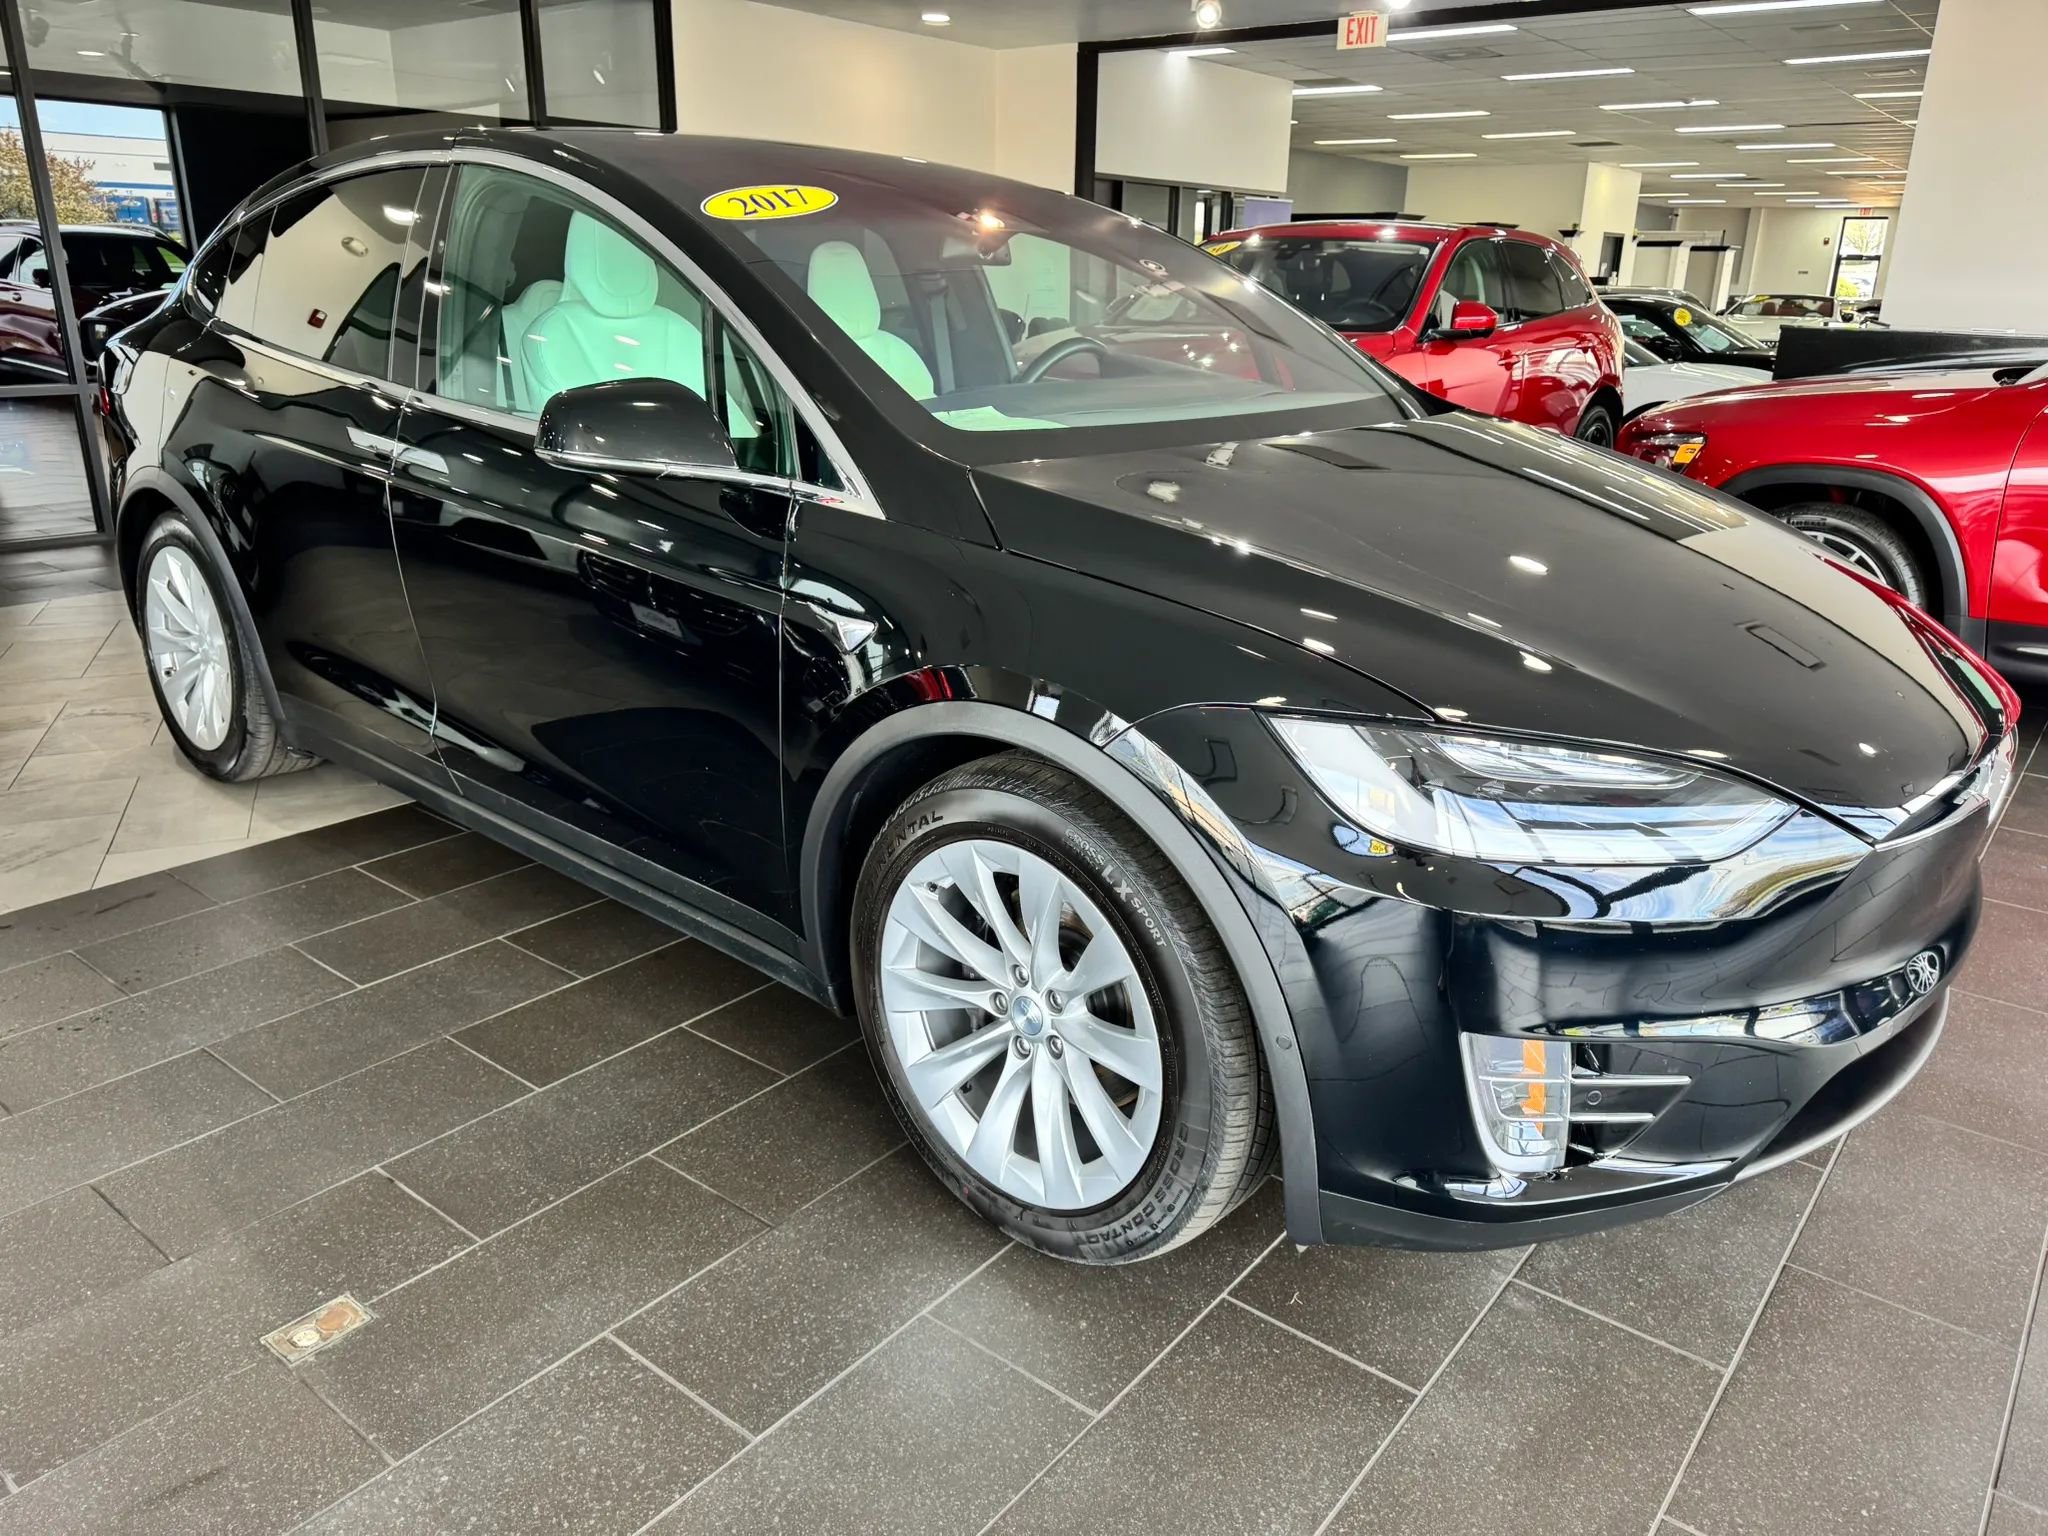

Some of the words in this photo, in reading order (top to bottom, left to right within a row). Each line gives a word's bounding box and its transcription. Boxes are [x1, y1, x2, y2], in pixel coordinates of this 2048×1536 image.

[1346, 16, 1378, 45] EXIT
[727, 188, 808, 216] 2017
[1065, 828, 1106, 866] CROSS
[1101, 864, 1134, 903] LX
[1130, 896, 1167, 947] SPORT
[1155, 1122, 1189, 1204] CROSS
